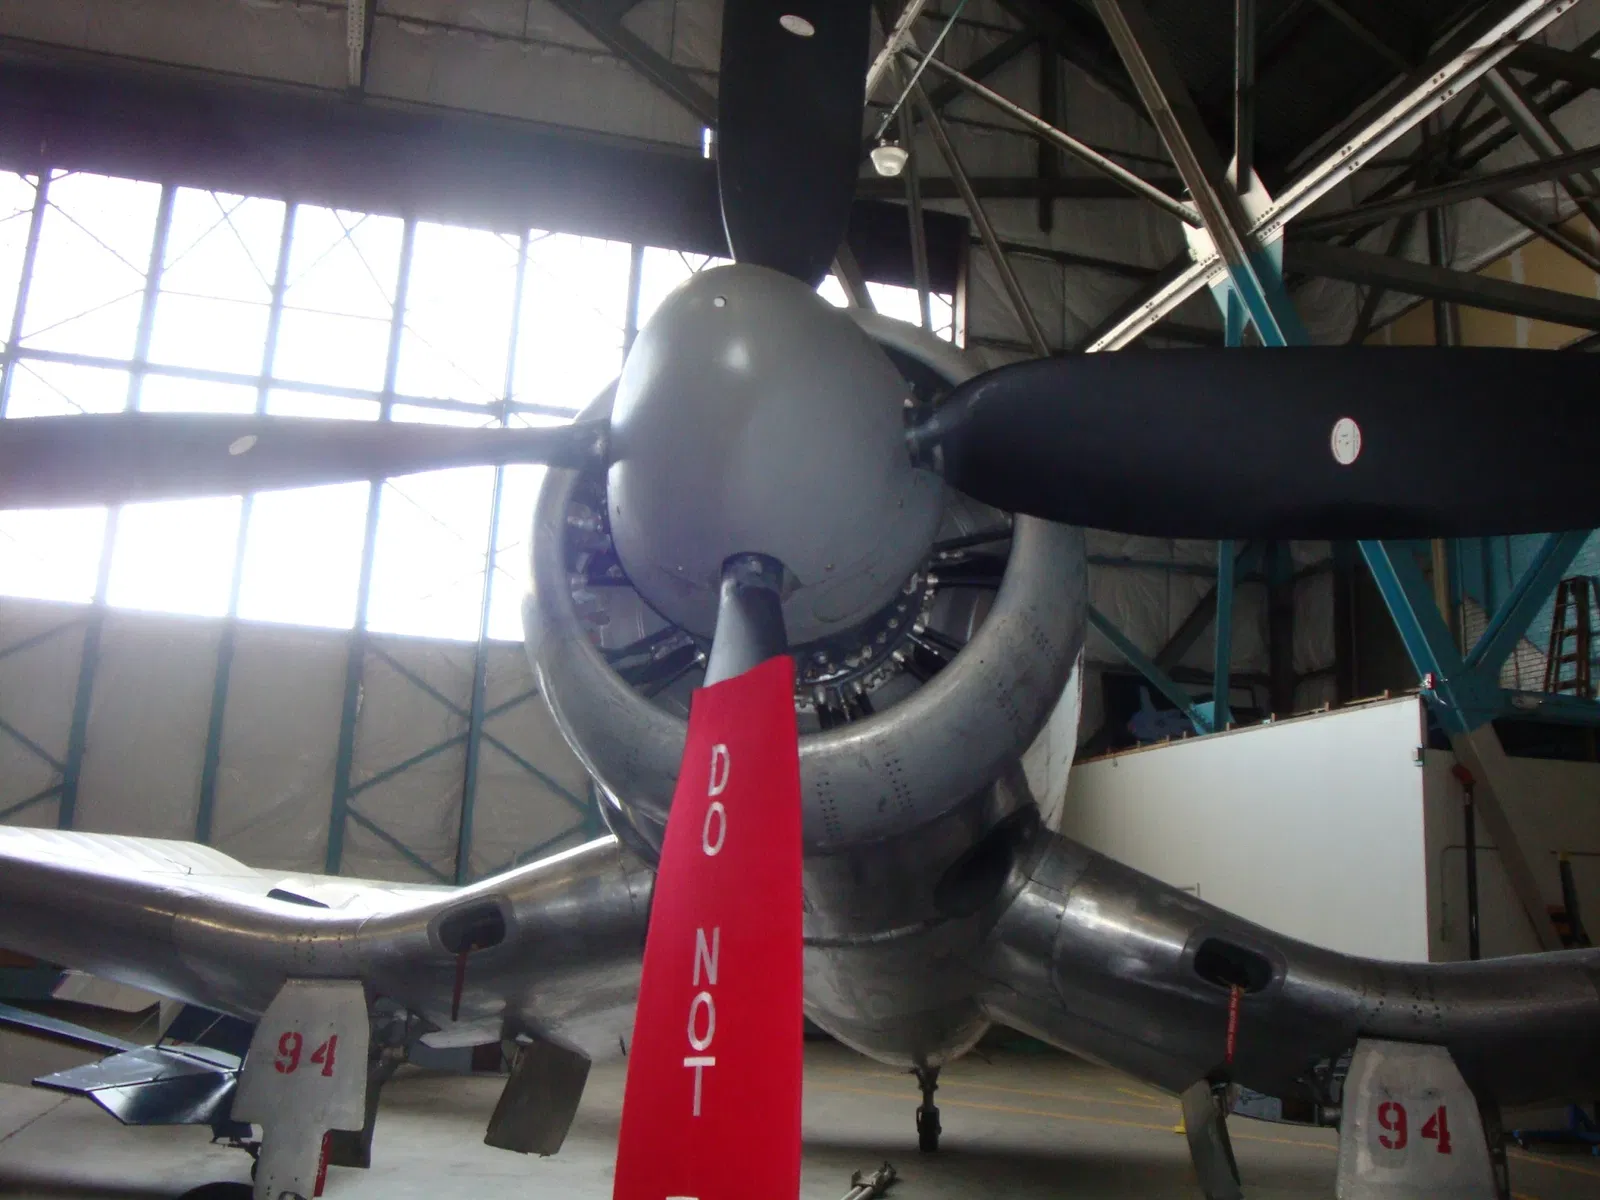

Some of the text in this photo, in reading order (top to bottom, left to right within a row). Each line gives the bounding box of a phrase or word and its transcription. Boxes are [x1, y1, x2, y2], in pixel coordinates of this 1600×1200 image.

[683, 743, 730, 1117] DO NOT
[274, 1031, 338, 1077] 94
[1377, 1101, 1452, 1155] 94
